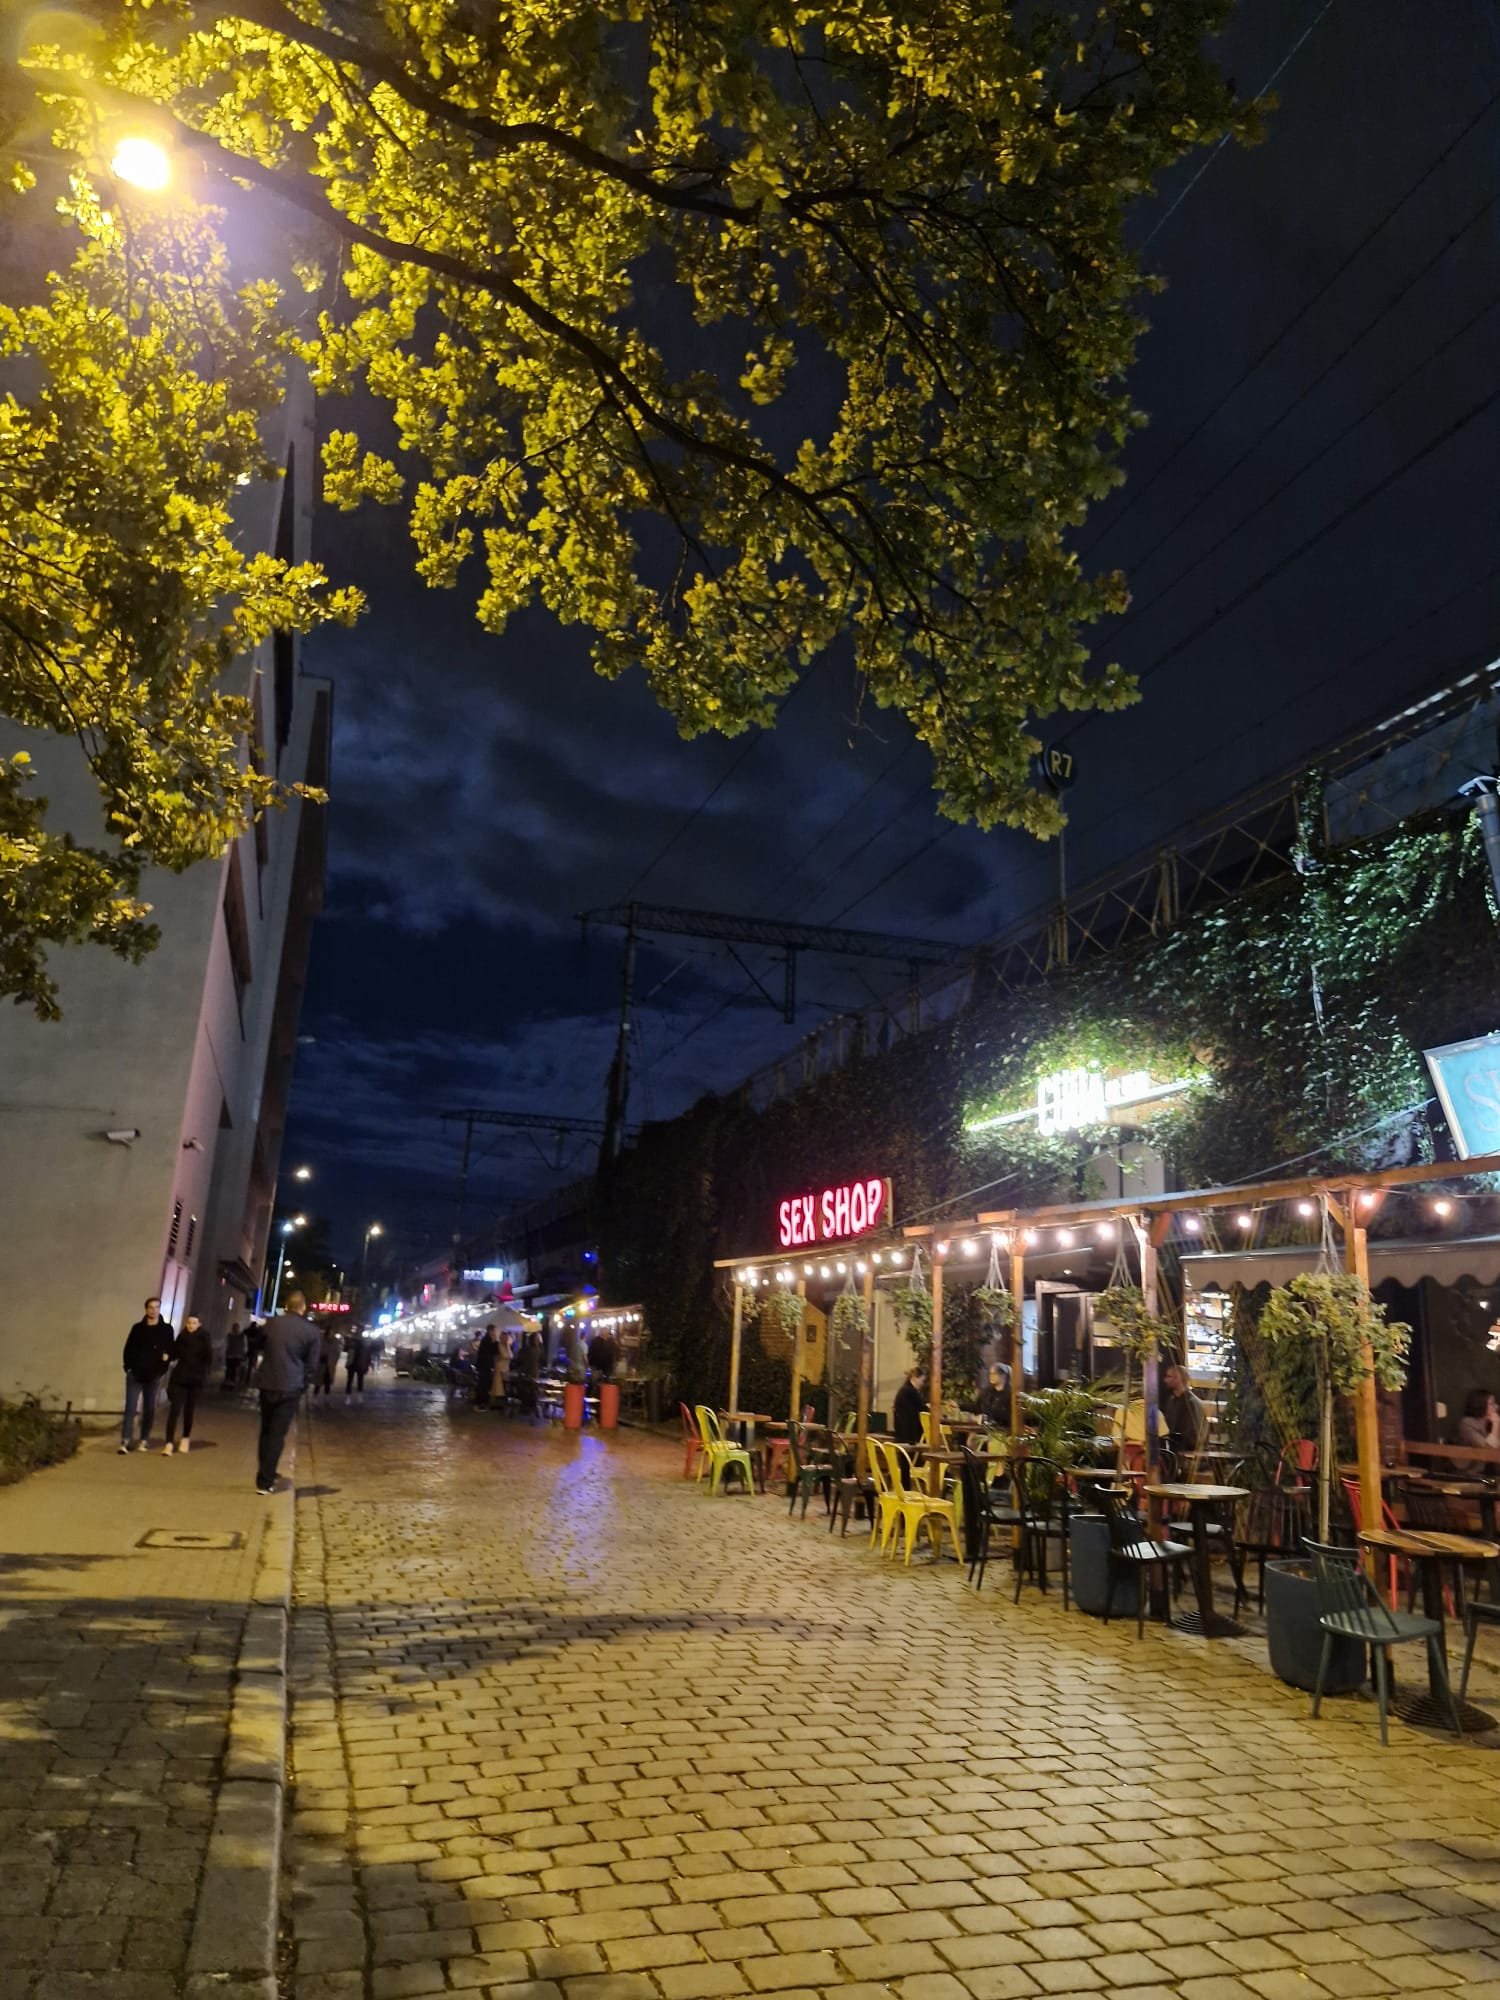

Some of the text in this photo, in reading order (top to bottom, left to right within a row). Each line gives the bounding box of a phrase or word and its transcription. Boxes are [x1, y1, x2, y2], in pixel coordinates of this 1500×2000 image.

[1051, 750, 1072, 778] R7
[779, 1179, 883, 1247] SEX SHOP
